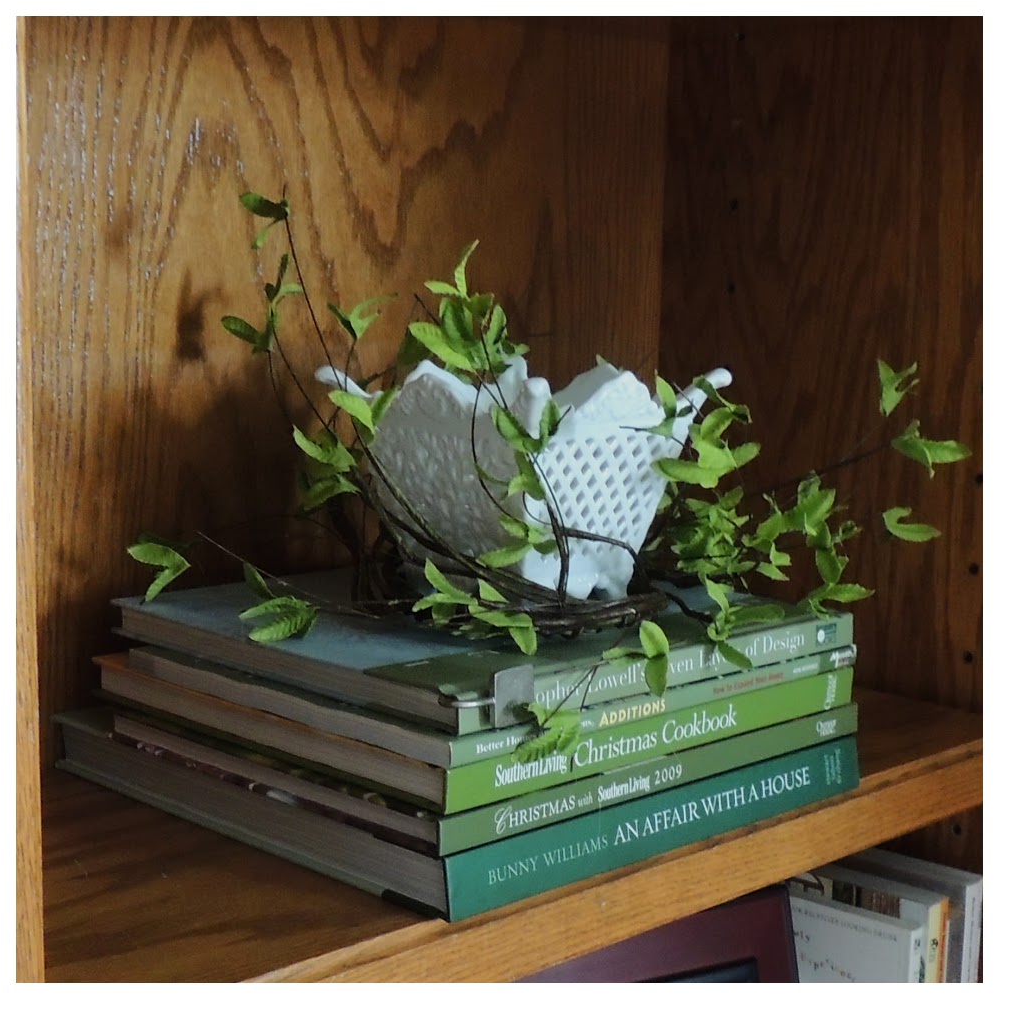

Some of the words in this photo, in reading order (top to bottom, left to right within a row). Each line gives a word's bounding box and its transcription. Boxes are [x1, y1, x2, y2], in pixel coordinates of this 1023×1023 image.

[589, 662, 646, 693] Lowell's
[745, 638, 760, 657] of
[763, 631, 805, 653] Design
[476, 739, 504, 754] Better
[599, 699, 667, 727] ADDITIONS
[574, 735, 658, 767] Christmas
[662, 709, 738, 745] Cookbook
[487, 856, 539, 885] BUNNY
[543, 835, 609, 867] WILLIAMS
[613, 822, 641, 846] AN
[641, 801, 701, 838] AFFAIR
[701, 787, 747, 817] WITH
[748, 783, 759, 803] A
[761, 766, 811, 799] HOUSE
[495, 794, 576, 835] CHRISTMAS
[577, 791, 594, 808] with
[654, 764, 683, 786] 2009
